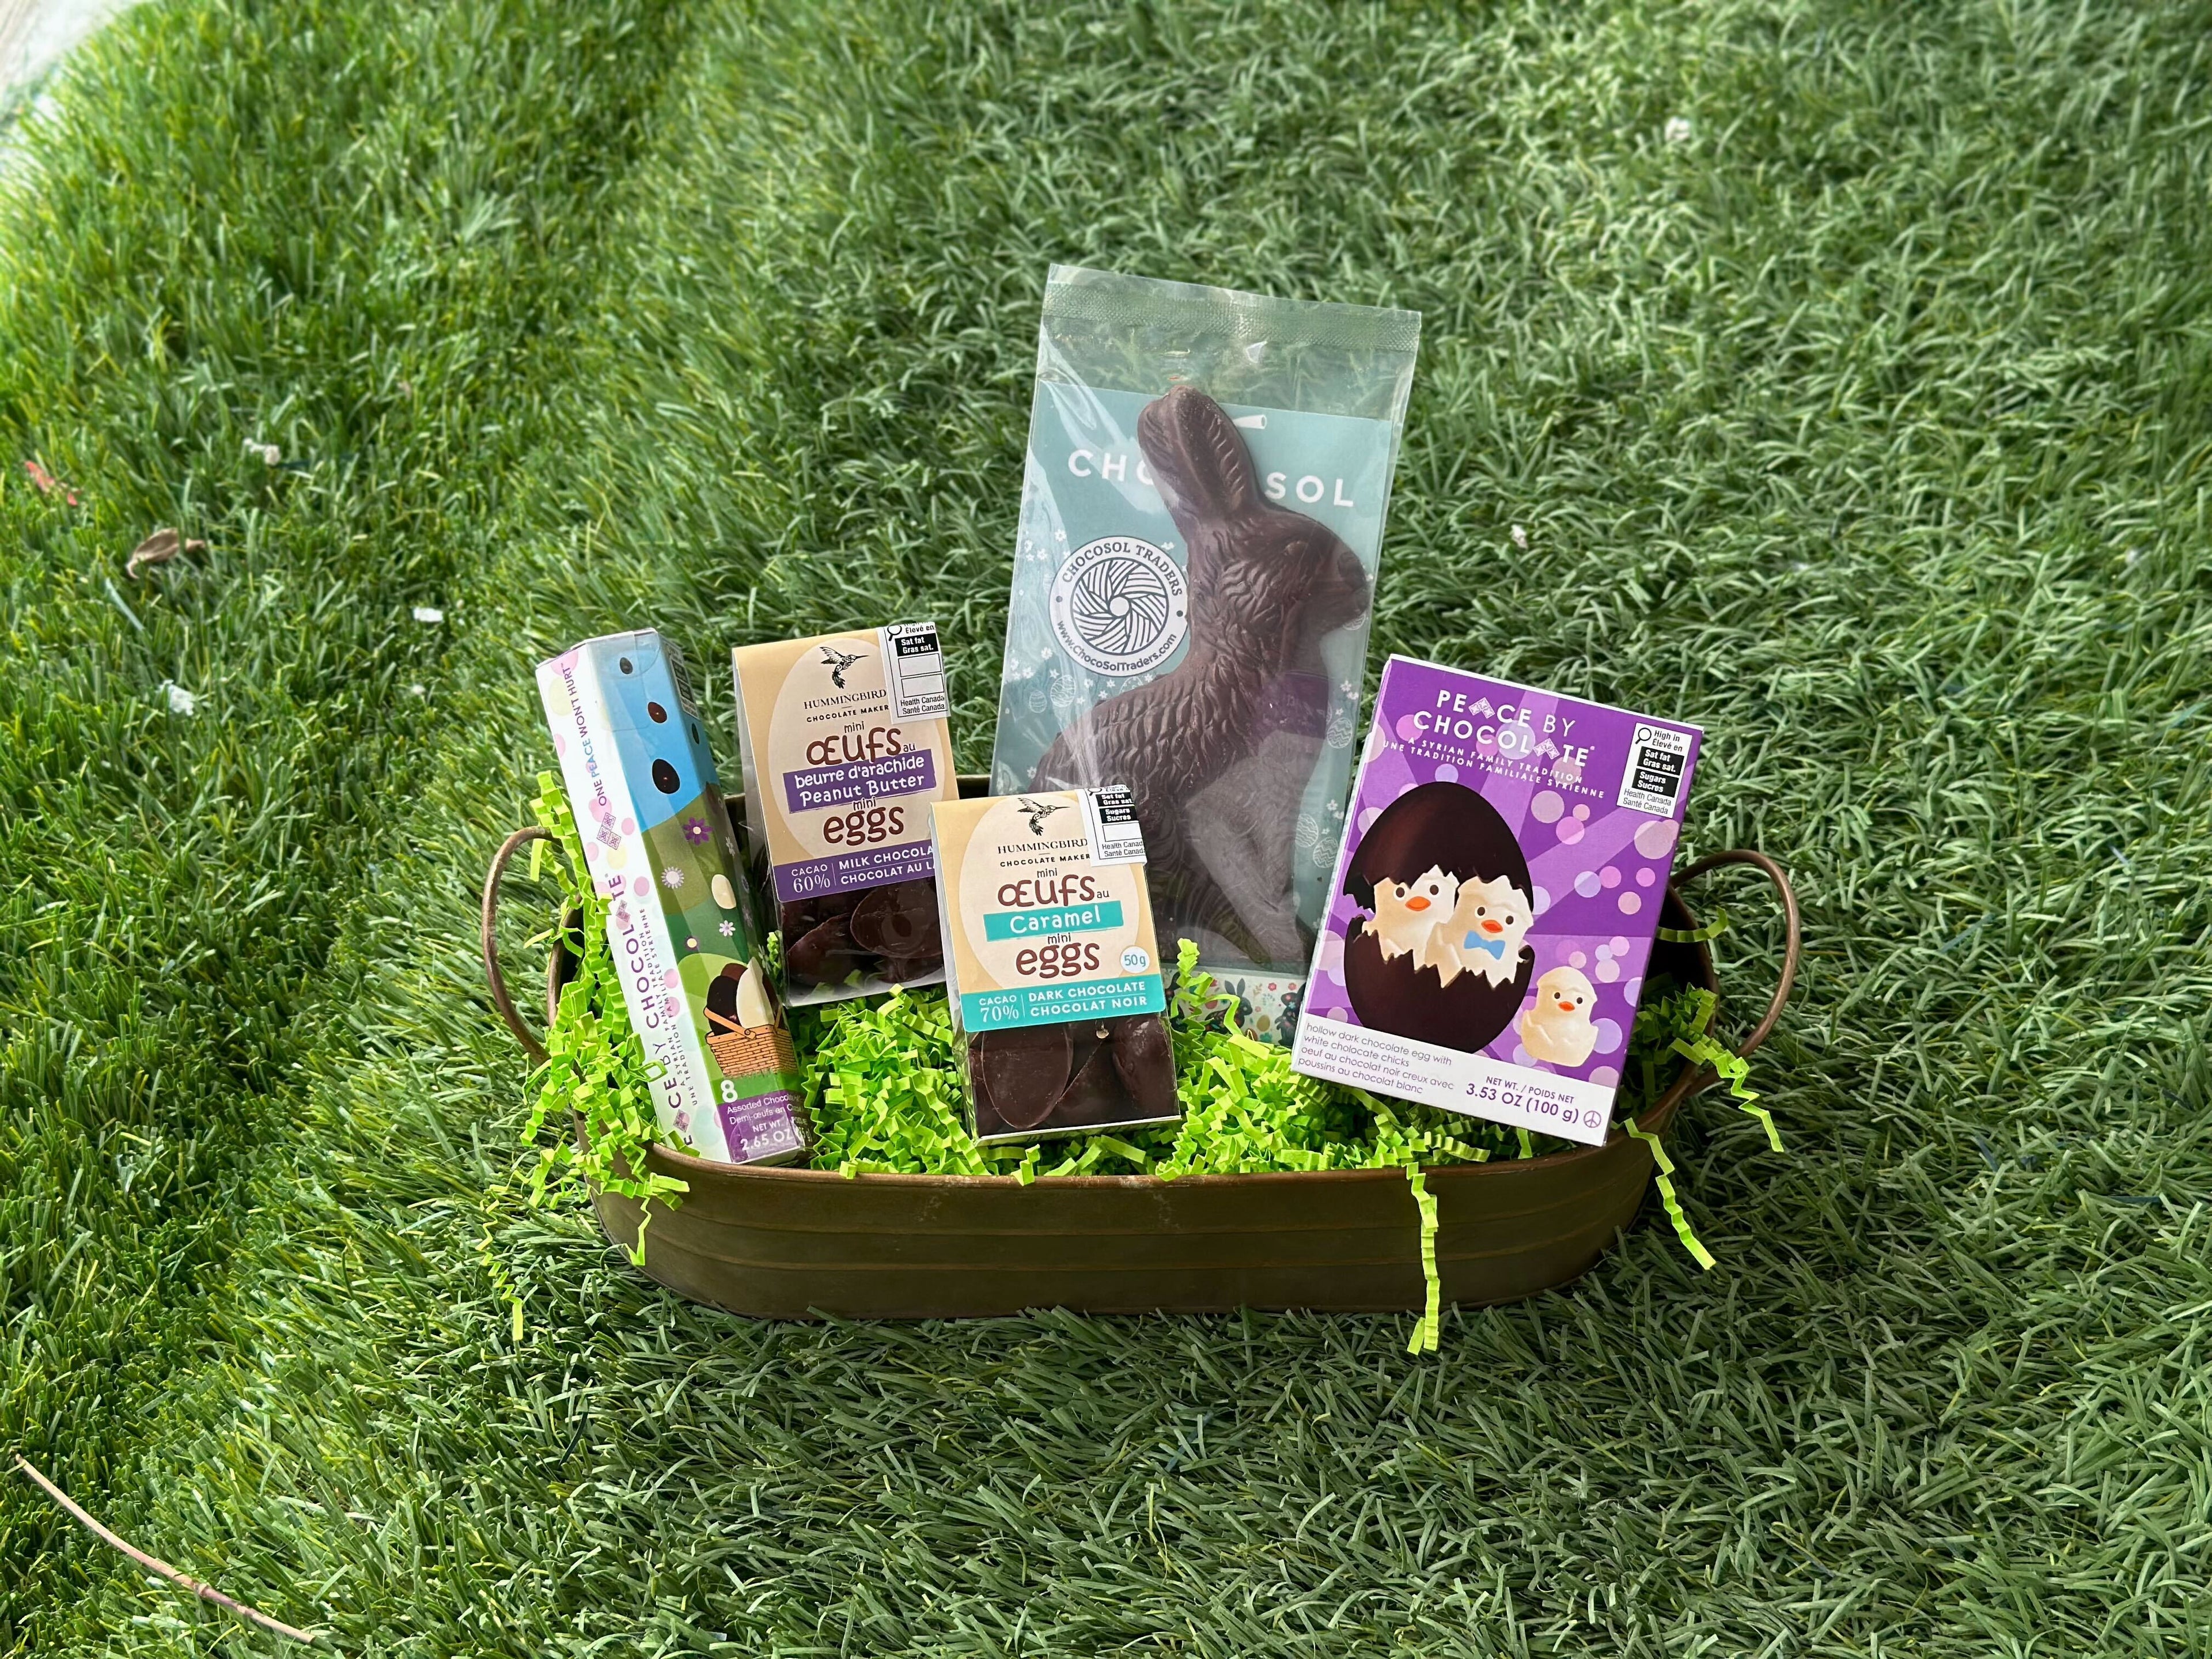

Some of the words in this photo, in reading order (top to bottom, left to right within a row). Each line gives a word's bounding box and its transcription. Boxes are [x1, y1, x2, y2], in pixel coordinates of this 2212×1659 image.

[1062, 542, 1130, 583] CHOCOSOL
[1135, 545, 1183, 596] TRADERS
[1058, 620, 1177, 671] www.ChocoSolTraders.com
[804, 689, 887, 710] HUMMINGBIRD
[900, 698, 920, 707] Health
[922, 695, 945, 704] Canada
[903, 706, 920, 715] Santé
[922, 703, 945, 712] Canada
[571, 698, 588, 738] WON'T
[806, 710, 857, 723] CHOCOLATE
[861, 704, 889, 714] MAKER
[844, 722, 865, 733] mini
[1543, 714, 1575, 737] BY
[1654, 730, 1671, 740] High
[1673, 734, 1680, 742] in
[903, 743, 916, 752] au
[1652, 738, 1672, 749] Élevé
[582, 738, 600, 778] PEACE
[1422, 740, 1464, 756] SYRIAN
[1471, 751, 1513, 767] FAMILY
[1520, 762, 1582, 783] TRADITION
[1643, 758, 1661, 768] Gras
[1662, 763, 1676, 772] sat.
[1645, 749, 1658, 759] Sat
[1659, 752, 1671, 762] fat
[794, 768, 844, 789] beurre
[848, 756, 925, 780] d'arachide
[1383, 741, 1404, 752] UNE
[1411, 747, 1472, 767] TRADITION
[1479, 763, 1541, 783] FAMILIALE
[1547, 779, 1604, 798] SYRIENNE
[1639, 771, 1666, 784] Sugars
[594, 779, 607, 806] ONE
[800, 785, 862, 806] Peanut
[866, 774, 925, 796] Butter
[1624, 788, 1645, 800] Health
[1647, 794, 1672, 806] Canada
[1638, 780, 1664, 793] Sucres
[853, 796, 876, 810] mini
[1623, 797, 1642, 808] Santé
[1643, 802, 1668, 815] Canada
[823, 806, 904, 846] eggs
[998, 838, 1088, 854] HUMMINGBIRD
[1102, 842, 1122, 850] Health
[1123, 840, 1143, 848] Canad
[1104, 849, 1122, 857] Santé
[839, 857, 870, 870] MILK
[873, 845, 933, 864] CHOCOLA
[1000, 857, 1055, 868] CHOCOLATE
[791, 864, 828, 877] CACAO
[840, 866, 903, 885] CHOCOLAT
[907, 863, 922, 874] AU
[1037, 868, 1058, 878] mini
[793, 874, 830, 893] 60%
[1097, 890, 1109, 899] au
[1010, 906, 1101, 934] Caramel
[639, 908, 657, 959] SYRIENNE
[1047, 933, 1071, 945] mini
[639, 932, 658, 988] TRADITION
[1016, 942, 1100, 979] eggs
[654, 963, 674, 1018] FAMILIALE
[979, 995, 1017, 1006] CACAO
[1029, 990, 1063, 1002] DARK
[1068, 981, 1145, 998] CHOCOLATE
[656, 994, 670, 1031] FAMILY
[980, 1004, 1019, 1022] 70%
[1030, 999, 1105, 1017] CHOCOLAT
[1112, 996, 1147, 1008] NOIR
[671, 1024, 691, 1081] TRADITION
[1304, 1036, 1328, 1047] white
[1331, 1042, 1378, 1059] cholocate
[1381, 1055, 1409, 1067] chicks
[1306, 1023, 1336, 1036] hollow
[1339, 1032, 1359, 1043] dark
[1361, 1037, 1409, 1055] chocolate
[1411, 1051, 1430, 1062] egg
[1433, 1055, 1452, 1065] with
[668, 1037, 683, 1075] SYRIAN
[1298, 1058, 1335, 1072] poussins
[1338, 1067, 1350, 1075] au
[1353, 1071, 1393, 1086] chocolat
[1396, 1080, 1423, 1093] blanc
[1302, 1047, 1323, 1057] oeuf
[1325, 1052, 1336, 1060] au
[1339, 1056, 1381, 1071] chocolat
[1383, 1067, 1400, 1076] noir
[1403, 1072, 1428, 1083] creux
[1430, 1078, 1454, 1089] avec
[689, 1085, 698, 1106] UNE
[721, 1080, 738, 1103] 8
[1486, 1076, 1502, 1086] NET
[1505, 1080, 1518, 1090] WT.
[1528, 1086, 1555, 1100] POIDS
[1558, 1094, 1574, 1104] NET
[727, 1099, 762, 1114] Assorted
[1466, 1083, 1497, 1100] 3.53
[1502, 1092, 1522, 1107] OZ
[1526, 1097, 1558, 1116] (100
[1562, 1108, 1579, 1123] g)
[752, 1122, 767, 1132] NET
[740, 1134, 769, 1151] 2.65
[773, 1128, 793, 1142] OZ
